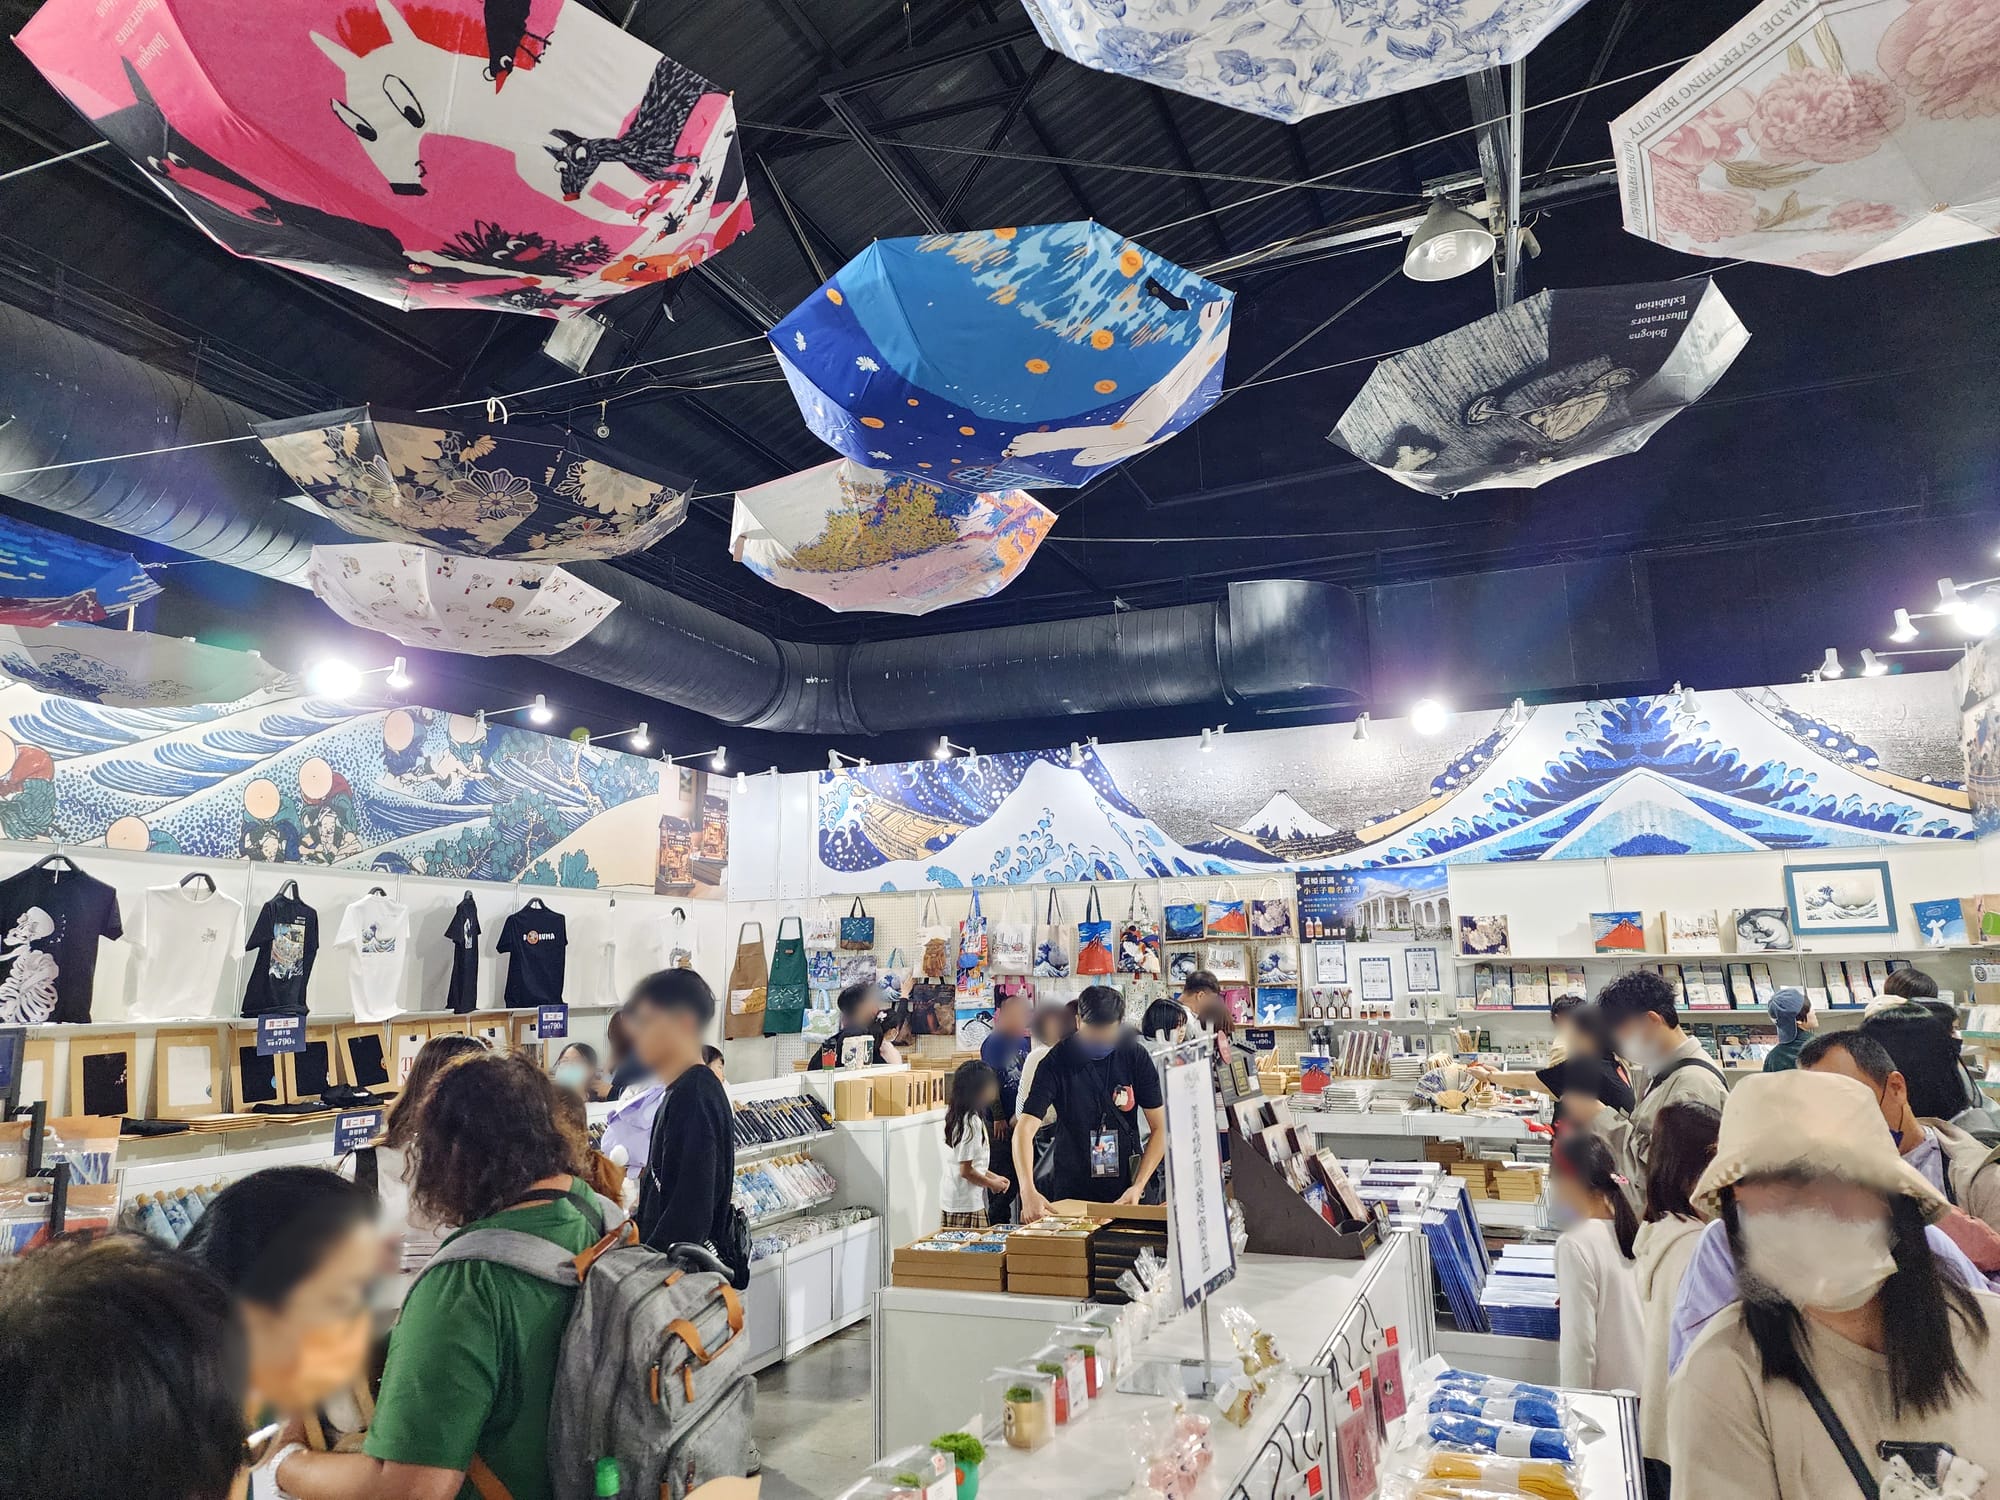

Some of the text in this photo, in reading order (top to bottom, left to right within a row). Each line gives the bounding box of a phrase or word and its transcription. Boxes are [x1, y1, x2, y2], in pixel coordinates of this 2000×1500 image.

[1628, 96, 1680, 139] BEAUTY
[1635, 295, 1686, 310] Exhibition
[1630, 310, 1688, 326] Illustrators
[1628, 328, 1668, 340] Bologna
